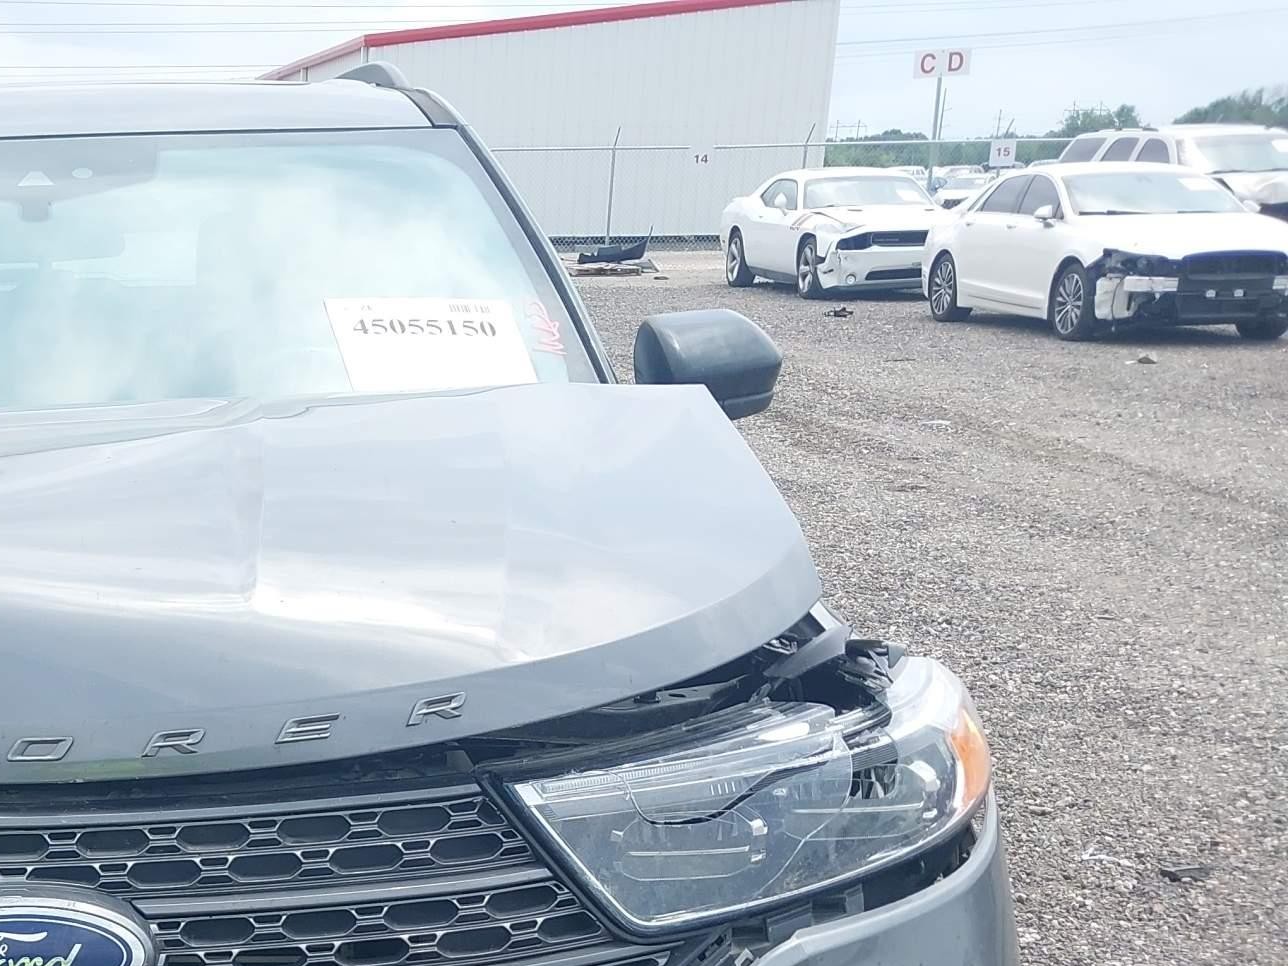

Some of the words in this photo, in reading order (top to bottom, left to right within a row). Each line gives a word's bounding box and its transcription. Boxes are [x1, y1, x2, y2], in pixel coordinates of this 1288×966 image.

[920, 53, 937, 74] C
[948, 51, 964, 72] D
[694, 154, 709, 164] 14
[996, 146, 1011, 157] 15
[352, 318, 497, 337] 45055150
